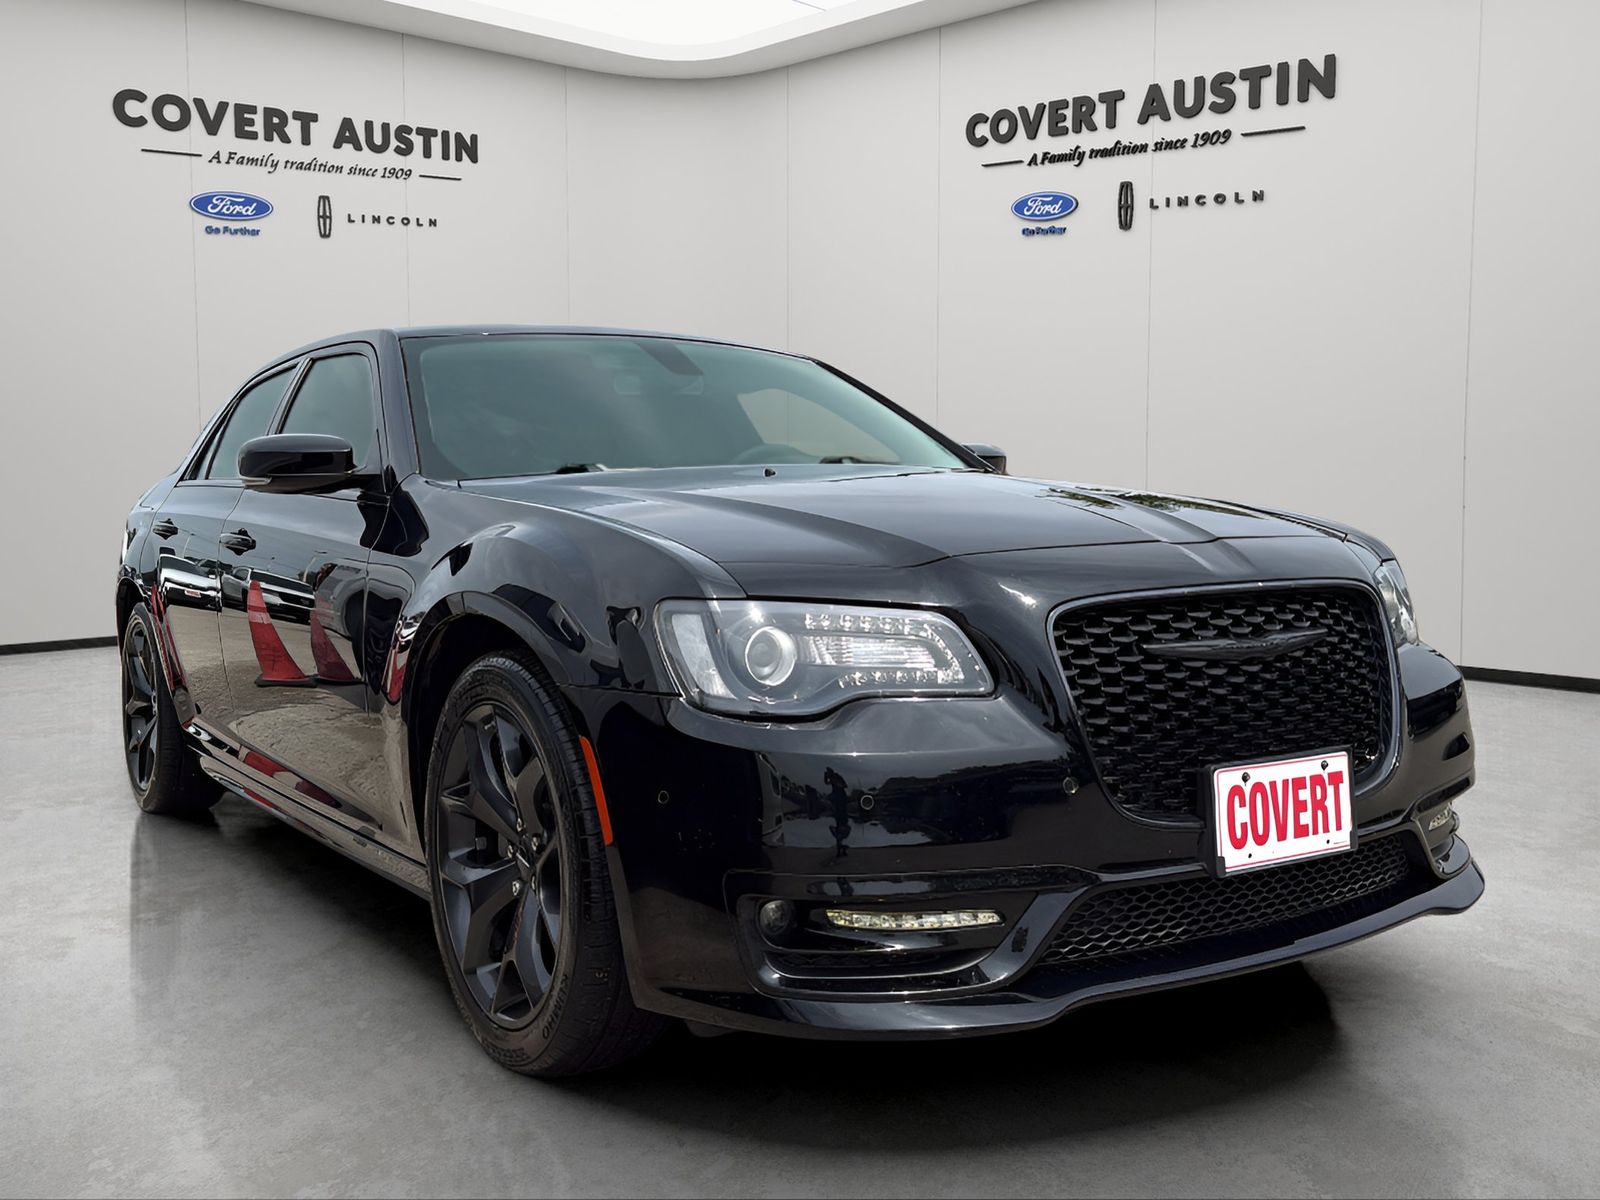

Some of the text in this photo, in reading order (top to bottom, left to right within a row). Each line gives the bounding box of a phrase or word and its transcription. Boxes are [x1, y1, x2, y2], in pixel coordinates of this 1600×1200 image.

[965, 53, 1337, 148] COVERT AUSTIN
[112, 88, 479, 164] COVERT AUSTIN
[1027, 128, 1232, 167] A Family tradition since 1909
[208, 150, 413, 180] A Family tradition since 1909
[207, 194, 257, 216] Ford
[1023, 196, 1063, 216] Ford
[1149, 189, 1265, 210] LINCOLN
[205, 225, 261, 236] Go Further
[347, 212, 438, 228] LINCOLN
[1226, 770, 1344, 850] COVERT
